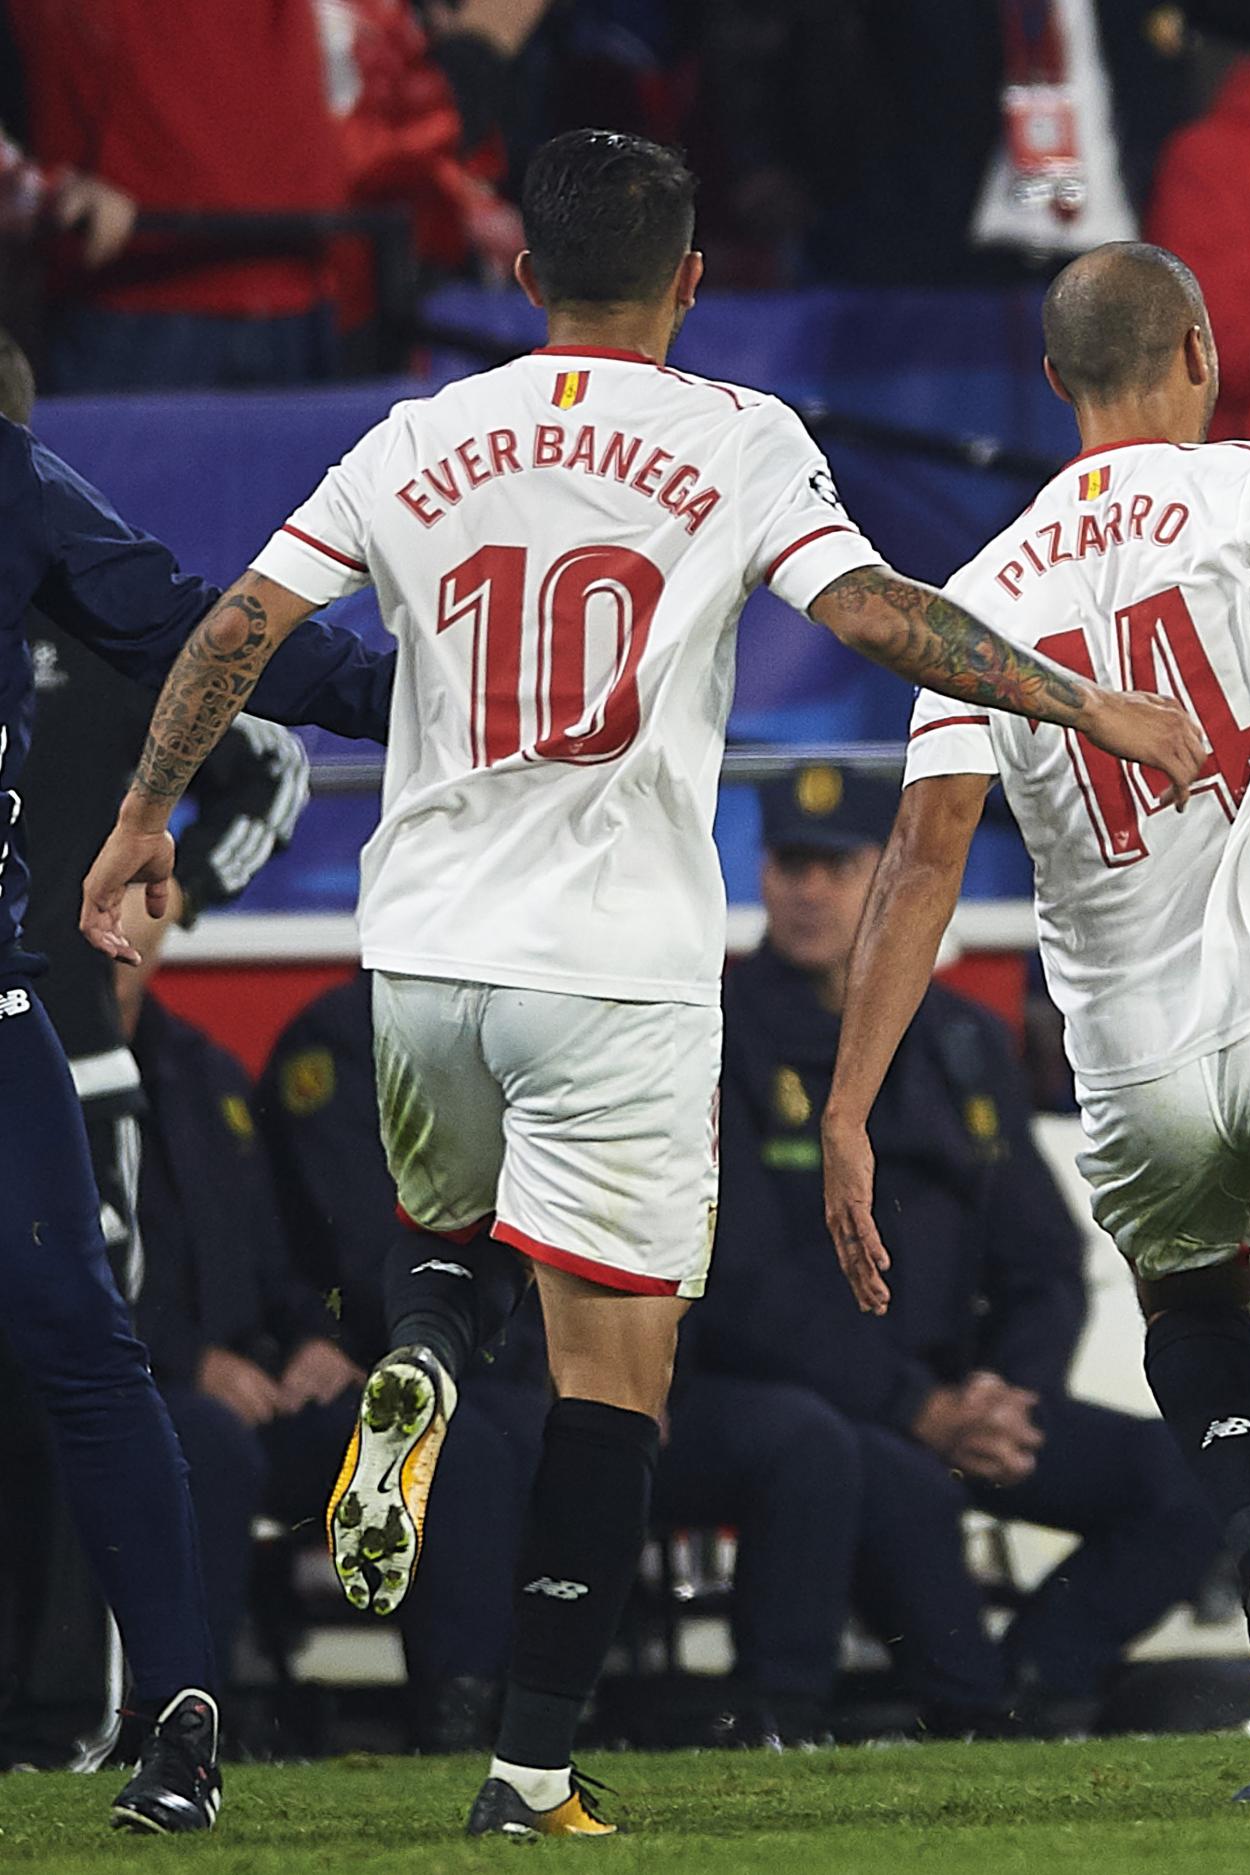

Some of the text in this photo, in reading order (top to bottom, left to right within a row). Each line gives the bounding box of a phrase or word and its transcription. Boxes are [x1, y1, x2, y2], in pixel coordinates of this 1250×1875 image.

[395, 424, 722, 536] EVER BANEGA
[994, 494, 1190, 601] PIZARRO
[436, 543, 666, 769] 10
